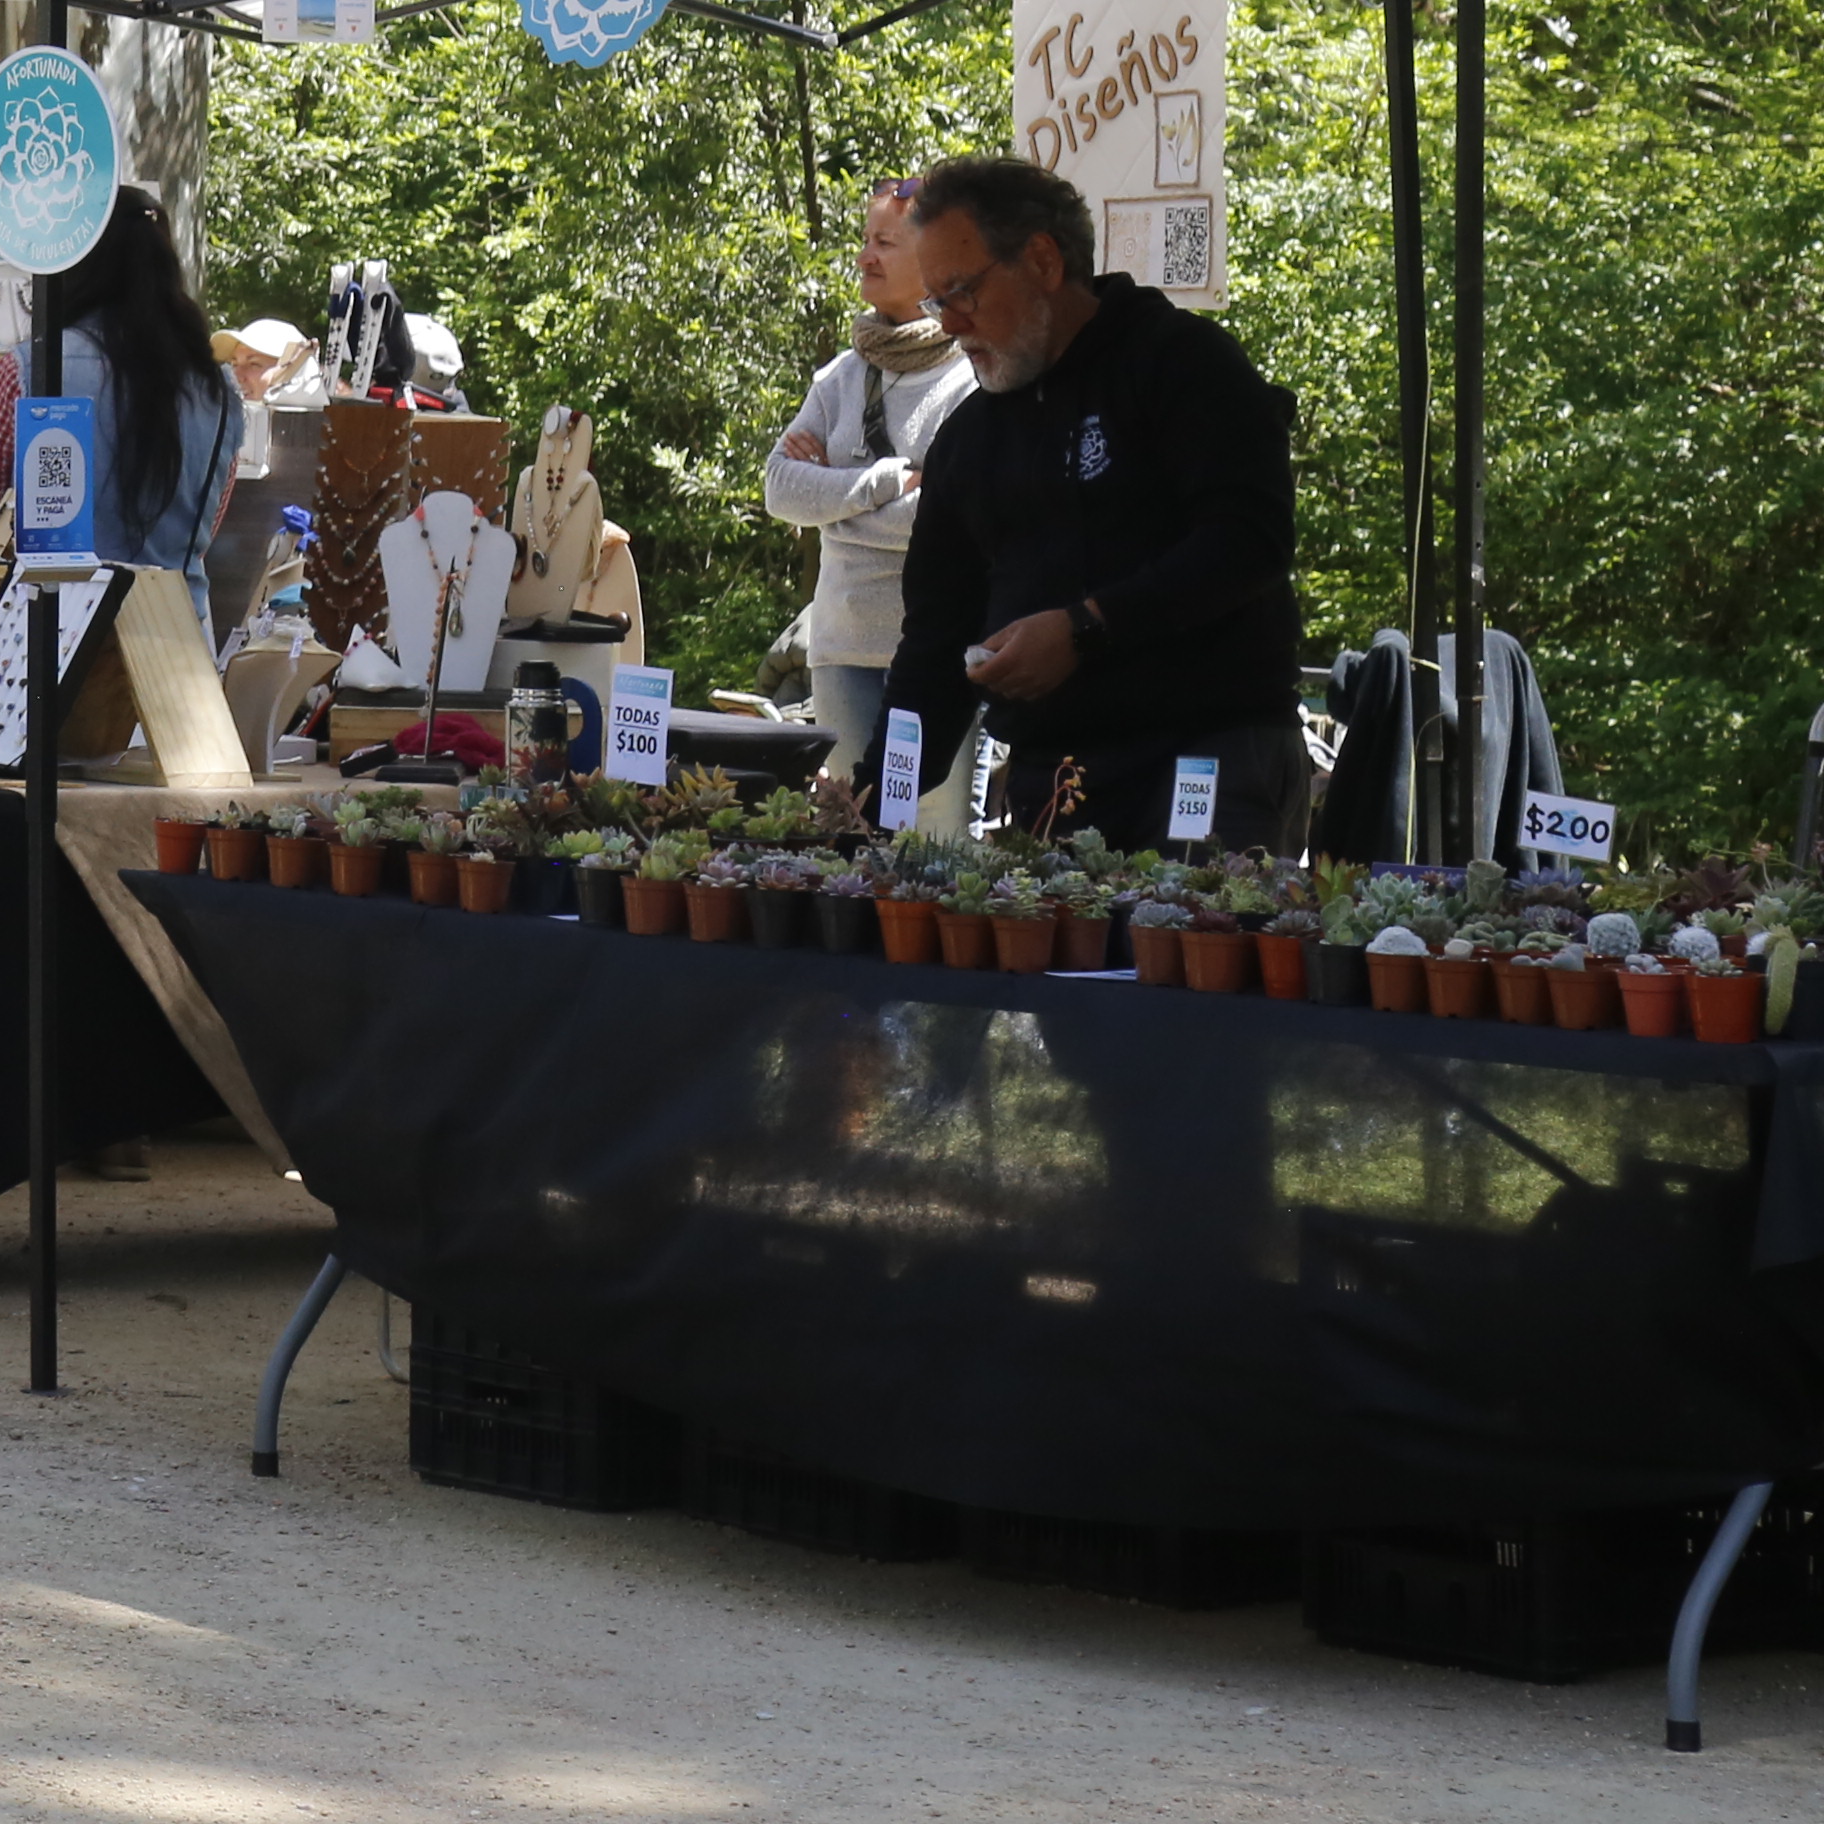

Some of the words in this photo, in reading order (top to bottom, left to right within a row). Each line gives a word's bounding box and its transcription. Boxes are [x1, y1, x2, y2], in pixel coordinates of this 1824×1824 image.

[1028, 13, 1094, 100] TC
[6, 56, 79, 91] AFORTUNADA
[1026, 15, 1199, 172] Diseños
[31, 216, 95, 261] SUCULENTAS
[615, 706, 661, 726] TODAS
[616, 729, 657, 755] $100
[888, 751, 914, 772] TODAS
[887, 777, 912, 801] $100
[1179, 782, 1211, 794] TODAS
[1178, 799, 1208, 816] $150
[1524, 802, 1610, 844] $200
